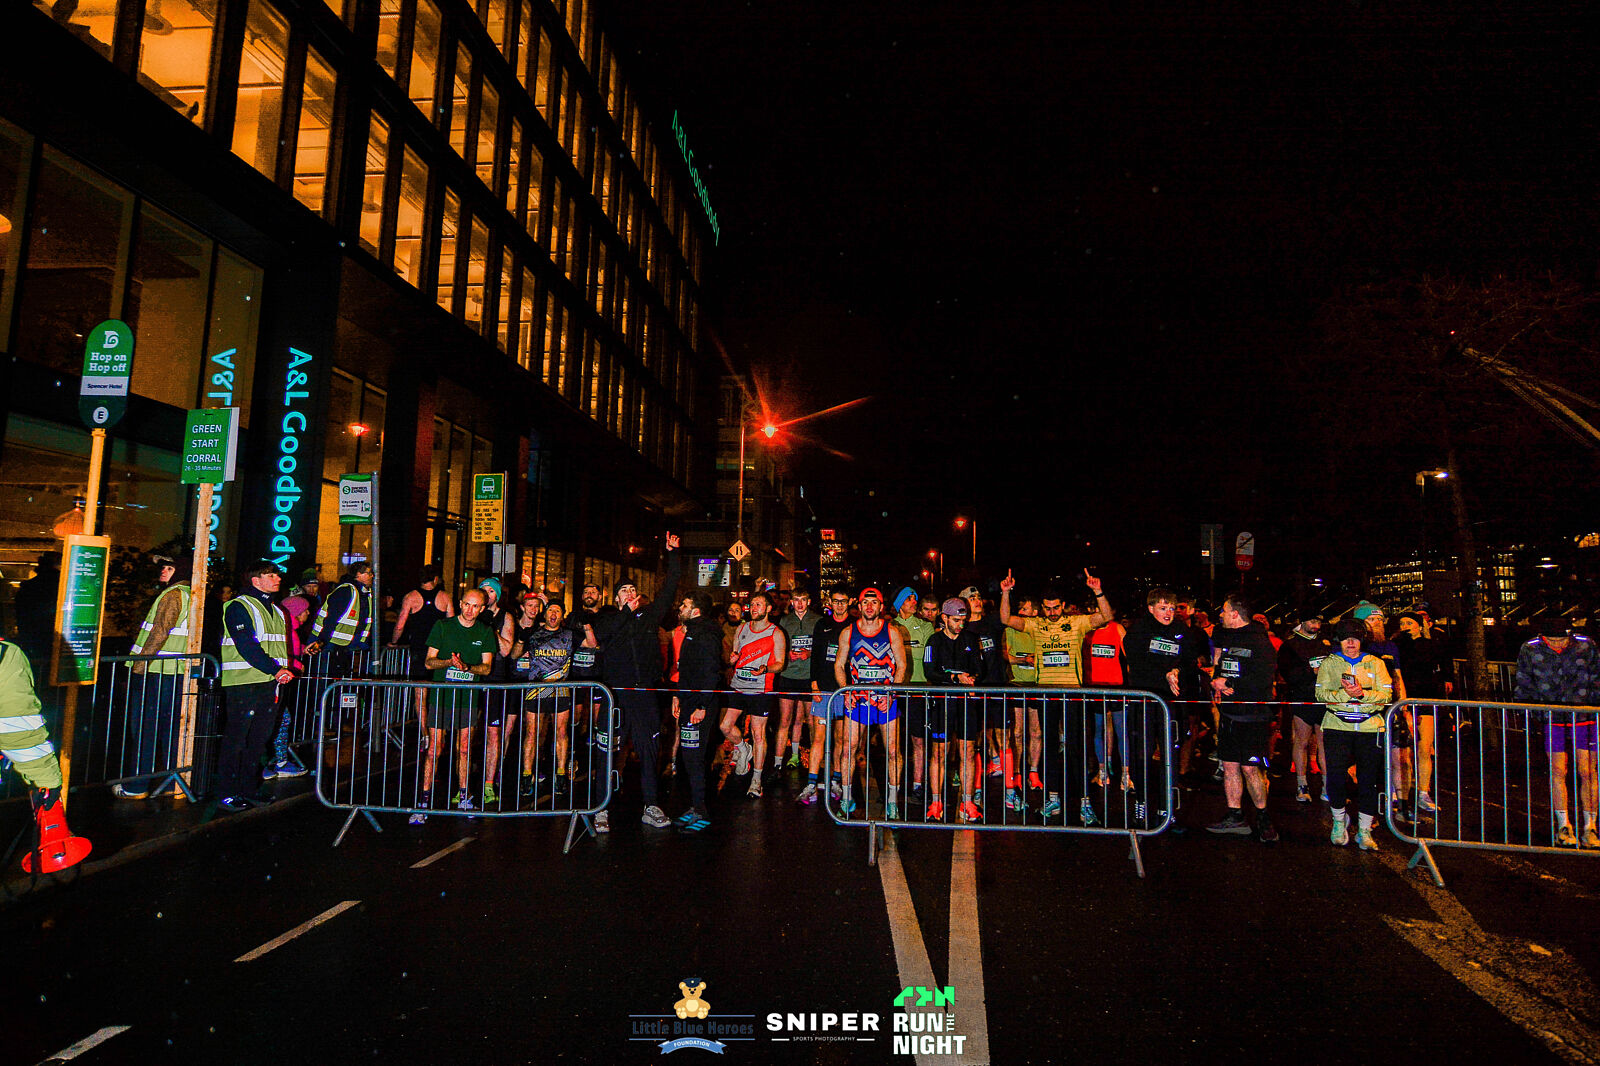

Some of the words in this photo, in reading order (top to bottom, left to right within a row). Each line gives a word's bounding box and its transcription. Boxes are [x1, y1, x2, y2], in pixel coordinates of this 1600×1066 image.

[671, 109, 687, 163] A&L
[688, 149, 719, 247] Goodbody
[90, 352, 112, 363] Hop
[89, 362, 111, 373] Hop
[112, 363, 127, 372] off
[283, 346, 313, 406] A&L
[97, 411, 104, 419] E
[192, 424, 222, 434] GREEN
[191, 439, 219, 448] START
[186, 454, 222, 463] CORRAL
[261, 411, 307, 574] Goodbody
[1041, 642, 1071, 650] dafabet
[1158, 643, 1172, 651] 705
